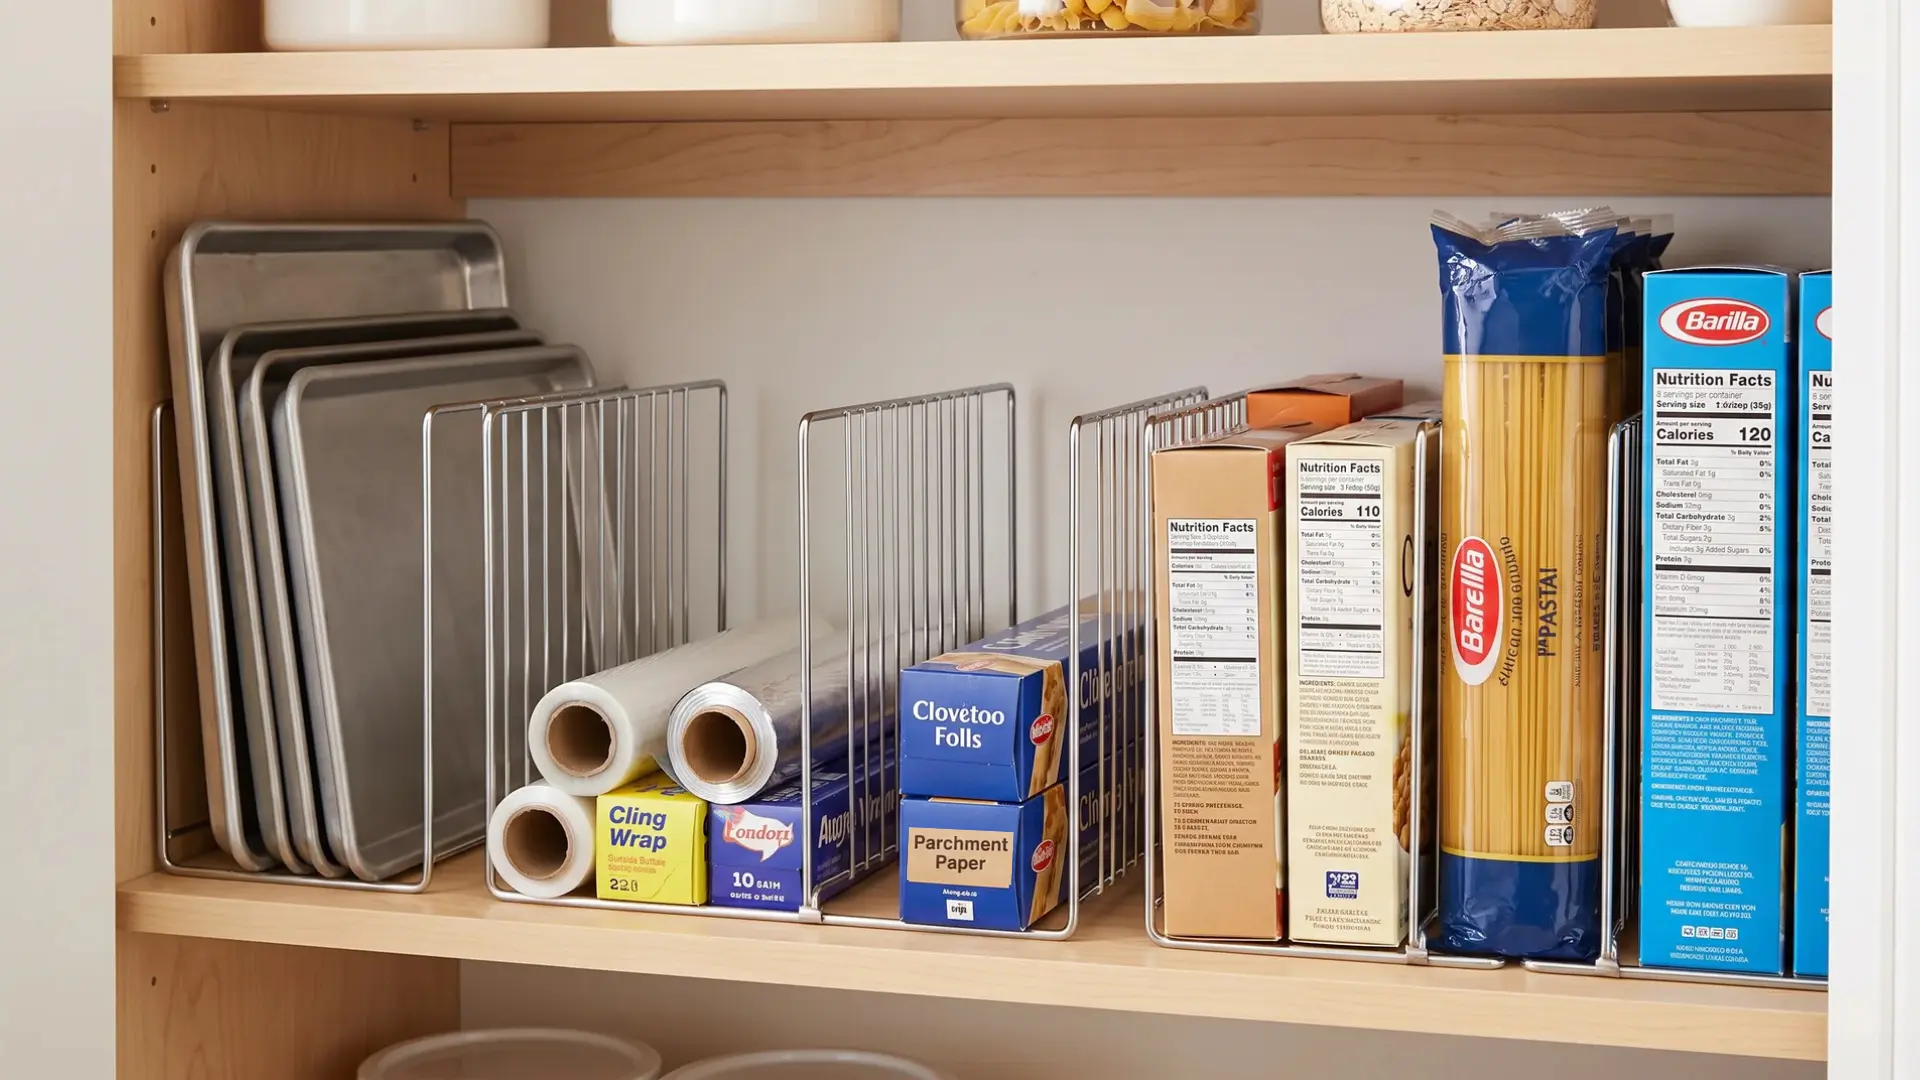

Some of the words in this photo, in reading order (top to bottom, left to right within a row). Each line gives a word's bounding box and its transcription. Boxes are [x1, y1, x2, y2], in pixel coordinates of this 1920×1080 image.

[1685, 311, 1760, 331] Barilla
[1657, 372, 1724, 386] Nutrition
[1730, 373, 1772, 386] Facts
[1663, 392, 1694, 400] servings
[1696, 392, 1707, 400] per
[1656, 400, 1687, 409] Serving
[1750, 402, 1772, 410] (35g)
[1656, 428, 1714, 440] Calories
[1740, 427, 1772, 441] 120
[1300, 462, 1347, 472] Nutrition
[1351, 463, 1380, 473] Facts
[1677, 458, 1688, 466] Fat
[1301, 507, 1343, 516] Calories
[1357, 506, 1380, 517] 110
[1676, 513, 1726, 521] Carbohydrate
[1170, 522, 1219, 532] Nutrition
[1223, 523, 1254, 532] Facts
[1680, 534, 1702, 542] Sugars
[1727, 546, 1749, 554] Sugars
[935, 726, 982, 748] Folls
[608, 806, 667, 830] Cling
[610, 828, 667, 852] Wrap
[914, 835, 1008, 852] Parchment
[936, 854, 986, 874] Paper
[732, 872, 754, 888] 10
